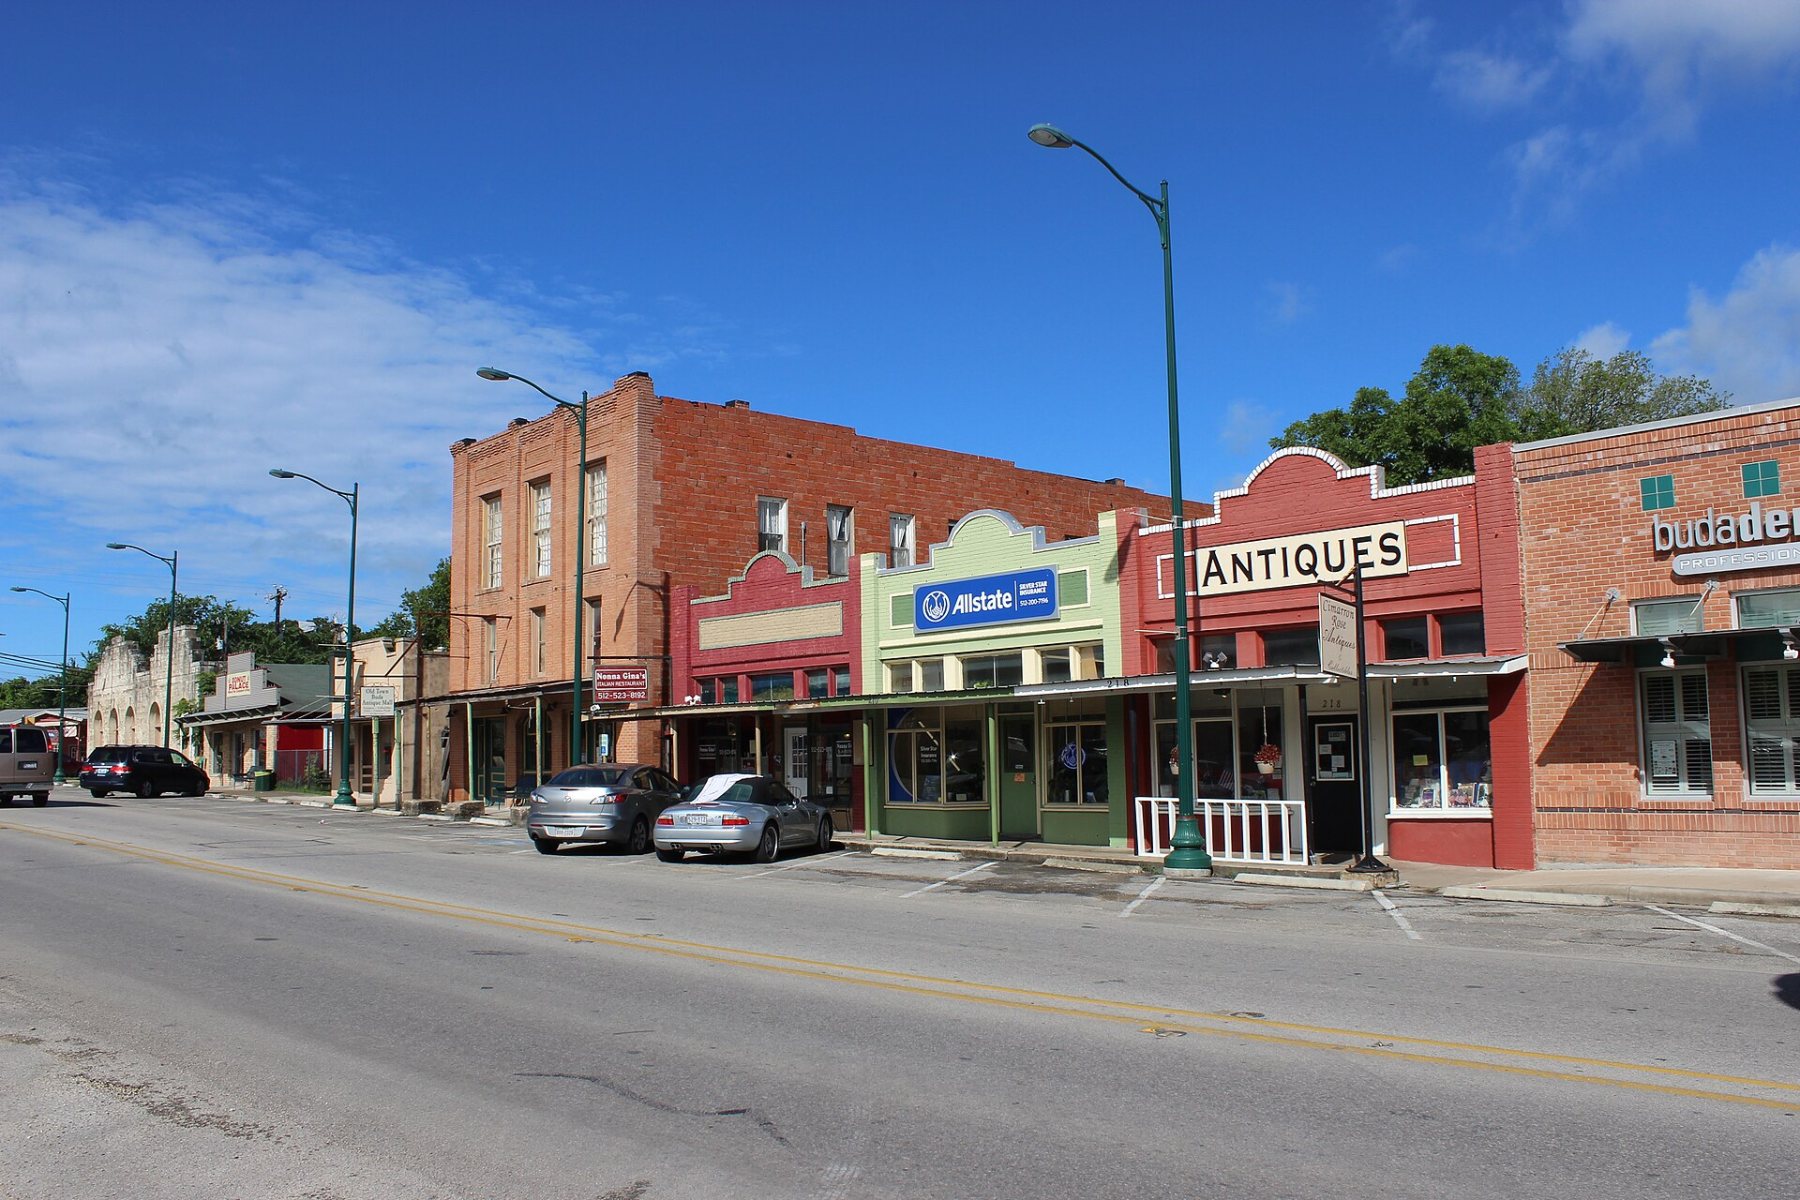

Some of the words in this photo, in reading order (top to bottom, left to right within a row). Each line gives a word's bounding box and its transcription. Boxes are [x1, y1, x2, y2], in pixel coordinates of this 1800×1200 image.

[1202, 531, 1402, 587] ANTIQUES
[1019, 582, 1034, 590] SILVER
[1035, 580, 1048, 588] STAR
[1019, 587, 1046, 596] INSURANCE
[952, 589, 1012, 615] Allstate
[1322, 600, 1355, 619] Cimarron
[1331, 615, 1347, 630] Rose
[1322, 627, 1356, 652] Antiques
[597, 672, 621, 680] Nonna
[622, 671, 646, 680] Gina's
[229, 681, 249, 690] PALACE
[1107, 679, 1130, 688] 218
[1322, 699, 1341, 708] 218
